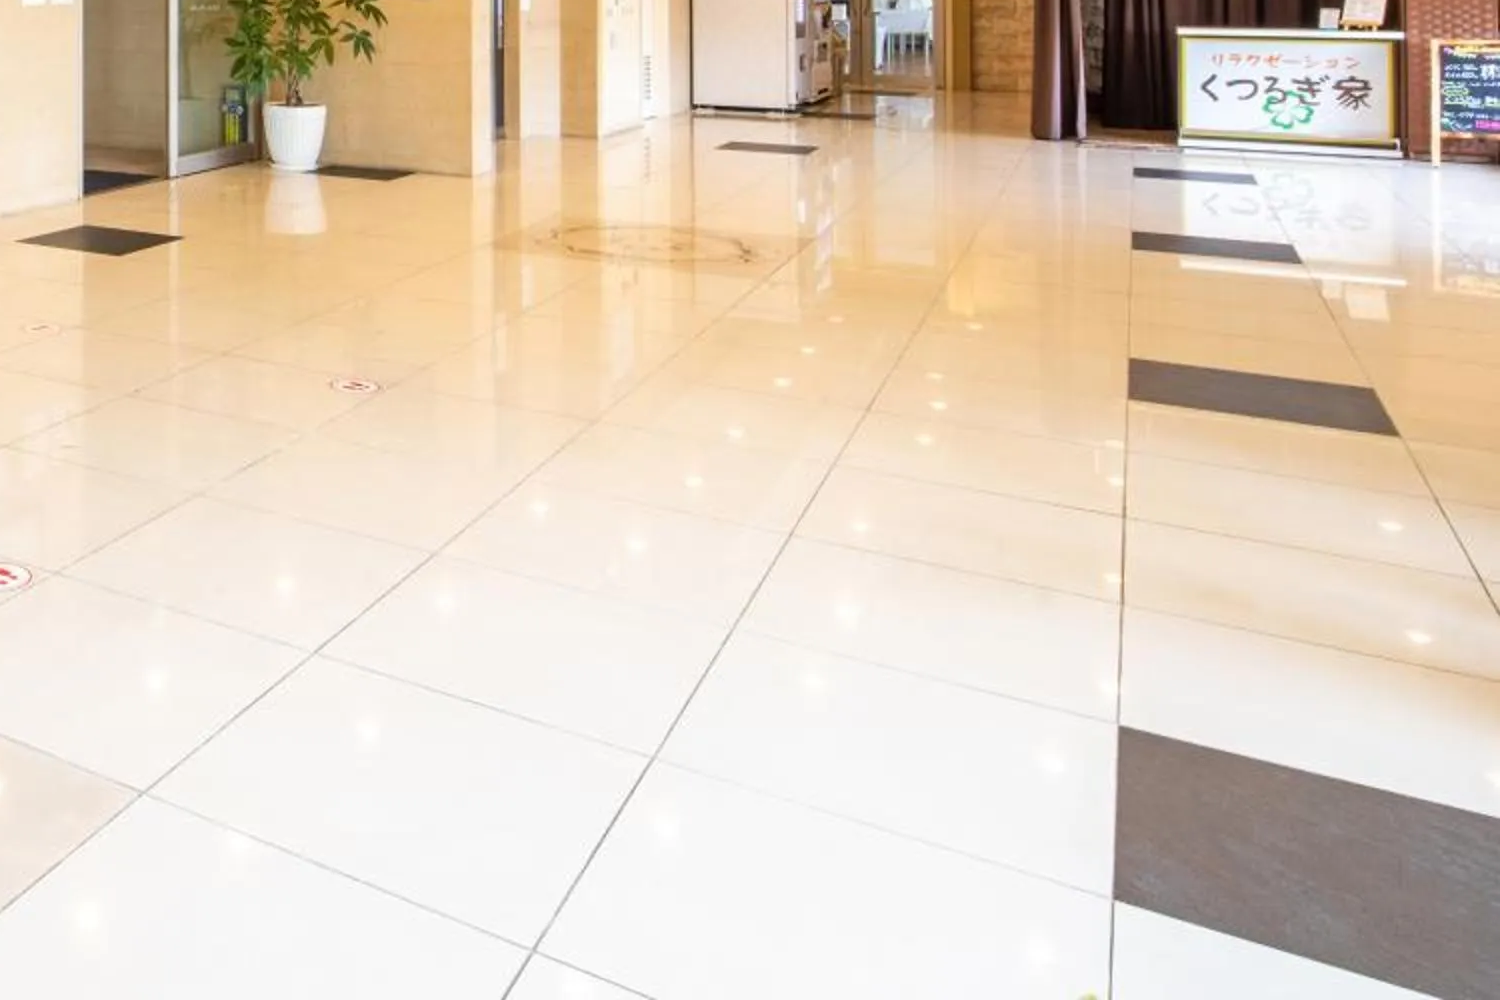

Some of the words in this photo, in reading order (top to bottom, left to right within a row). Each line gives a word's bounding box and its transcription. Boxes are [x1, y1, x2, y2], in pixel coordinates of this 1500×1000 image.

[1211, 53, 1360, 69] リラクゼーション
